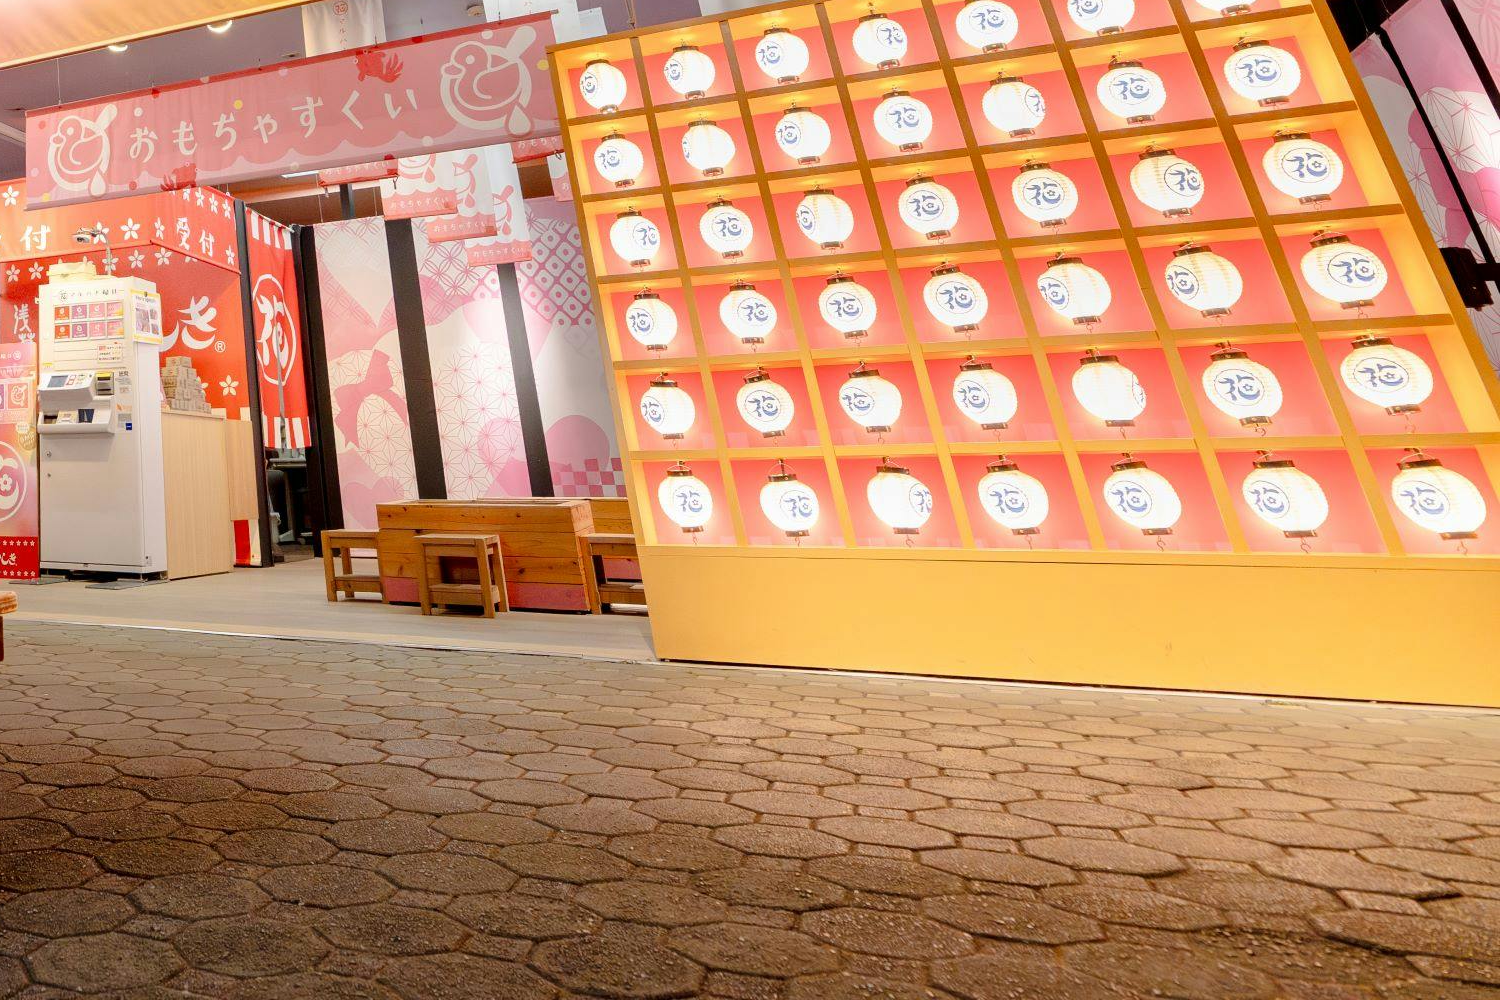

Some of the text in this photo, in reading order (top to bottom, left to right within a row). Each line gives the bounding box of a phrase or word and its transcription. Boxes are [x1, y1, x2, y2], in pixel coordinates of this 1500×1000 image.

[974, 9, 1005, 30] 花
[757, 46, 780, 67] 花
[665, 62, 682, 82] 花
[1238, 59, 1279, 83] 花
[1117, 77, 1152, 100] 花
[129, 88, 418, 164] おもちゃすくい
[889, 106, 920, 129] 花
[778, 125, 802, 145] 花
[600, 150, 620, 169] 花
[1287, 152, 1328, 179] 花
[1173, 164, 1201, 191] 花
[390, 197, 449, 209] おもちゃすくい
[1029, 181, 1062, 207] 花
[911, 195, 943, 220] 花
[176, 217, 215, 257] 受付
[434, 221, 486, 233] おもちゃすくい
[716, 216, 742, 239] 花
[473, 247, 525, 258] おもちゃすくい
[1168, 269, 1196, 295] 花
[1336, 257, 1381, 285] 花
[832, 297, 862, 319] 花
[943, 287, 975, 311] 花
[630, 309, 652, 333] 花
[745, 302, 770, 323] 花
[255, 294, 289, 370] 花
[1217, 373, 1264, 402] 花
[1359, 363, 1404, 388] 花
[745, 395, 781, 418] 花
[844, 391, 874, 412] 花
[958, 385, 988, 408] 花
[643, 400, 662, 422] 花
[678, 489, 702, 512] 花
[784, 494, 812, 518] 花
[991, 488, 1026, 514] 花
[1107, 486, 1148, 512] 花
[1250, 488, 1287, 516] 花
[1400, 486, 1446, 516] 花
